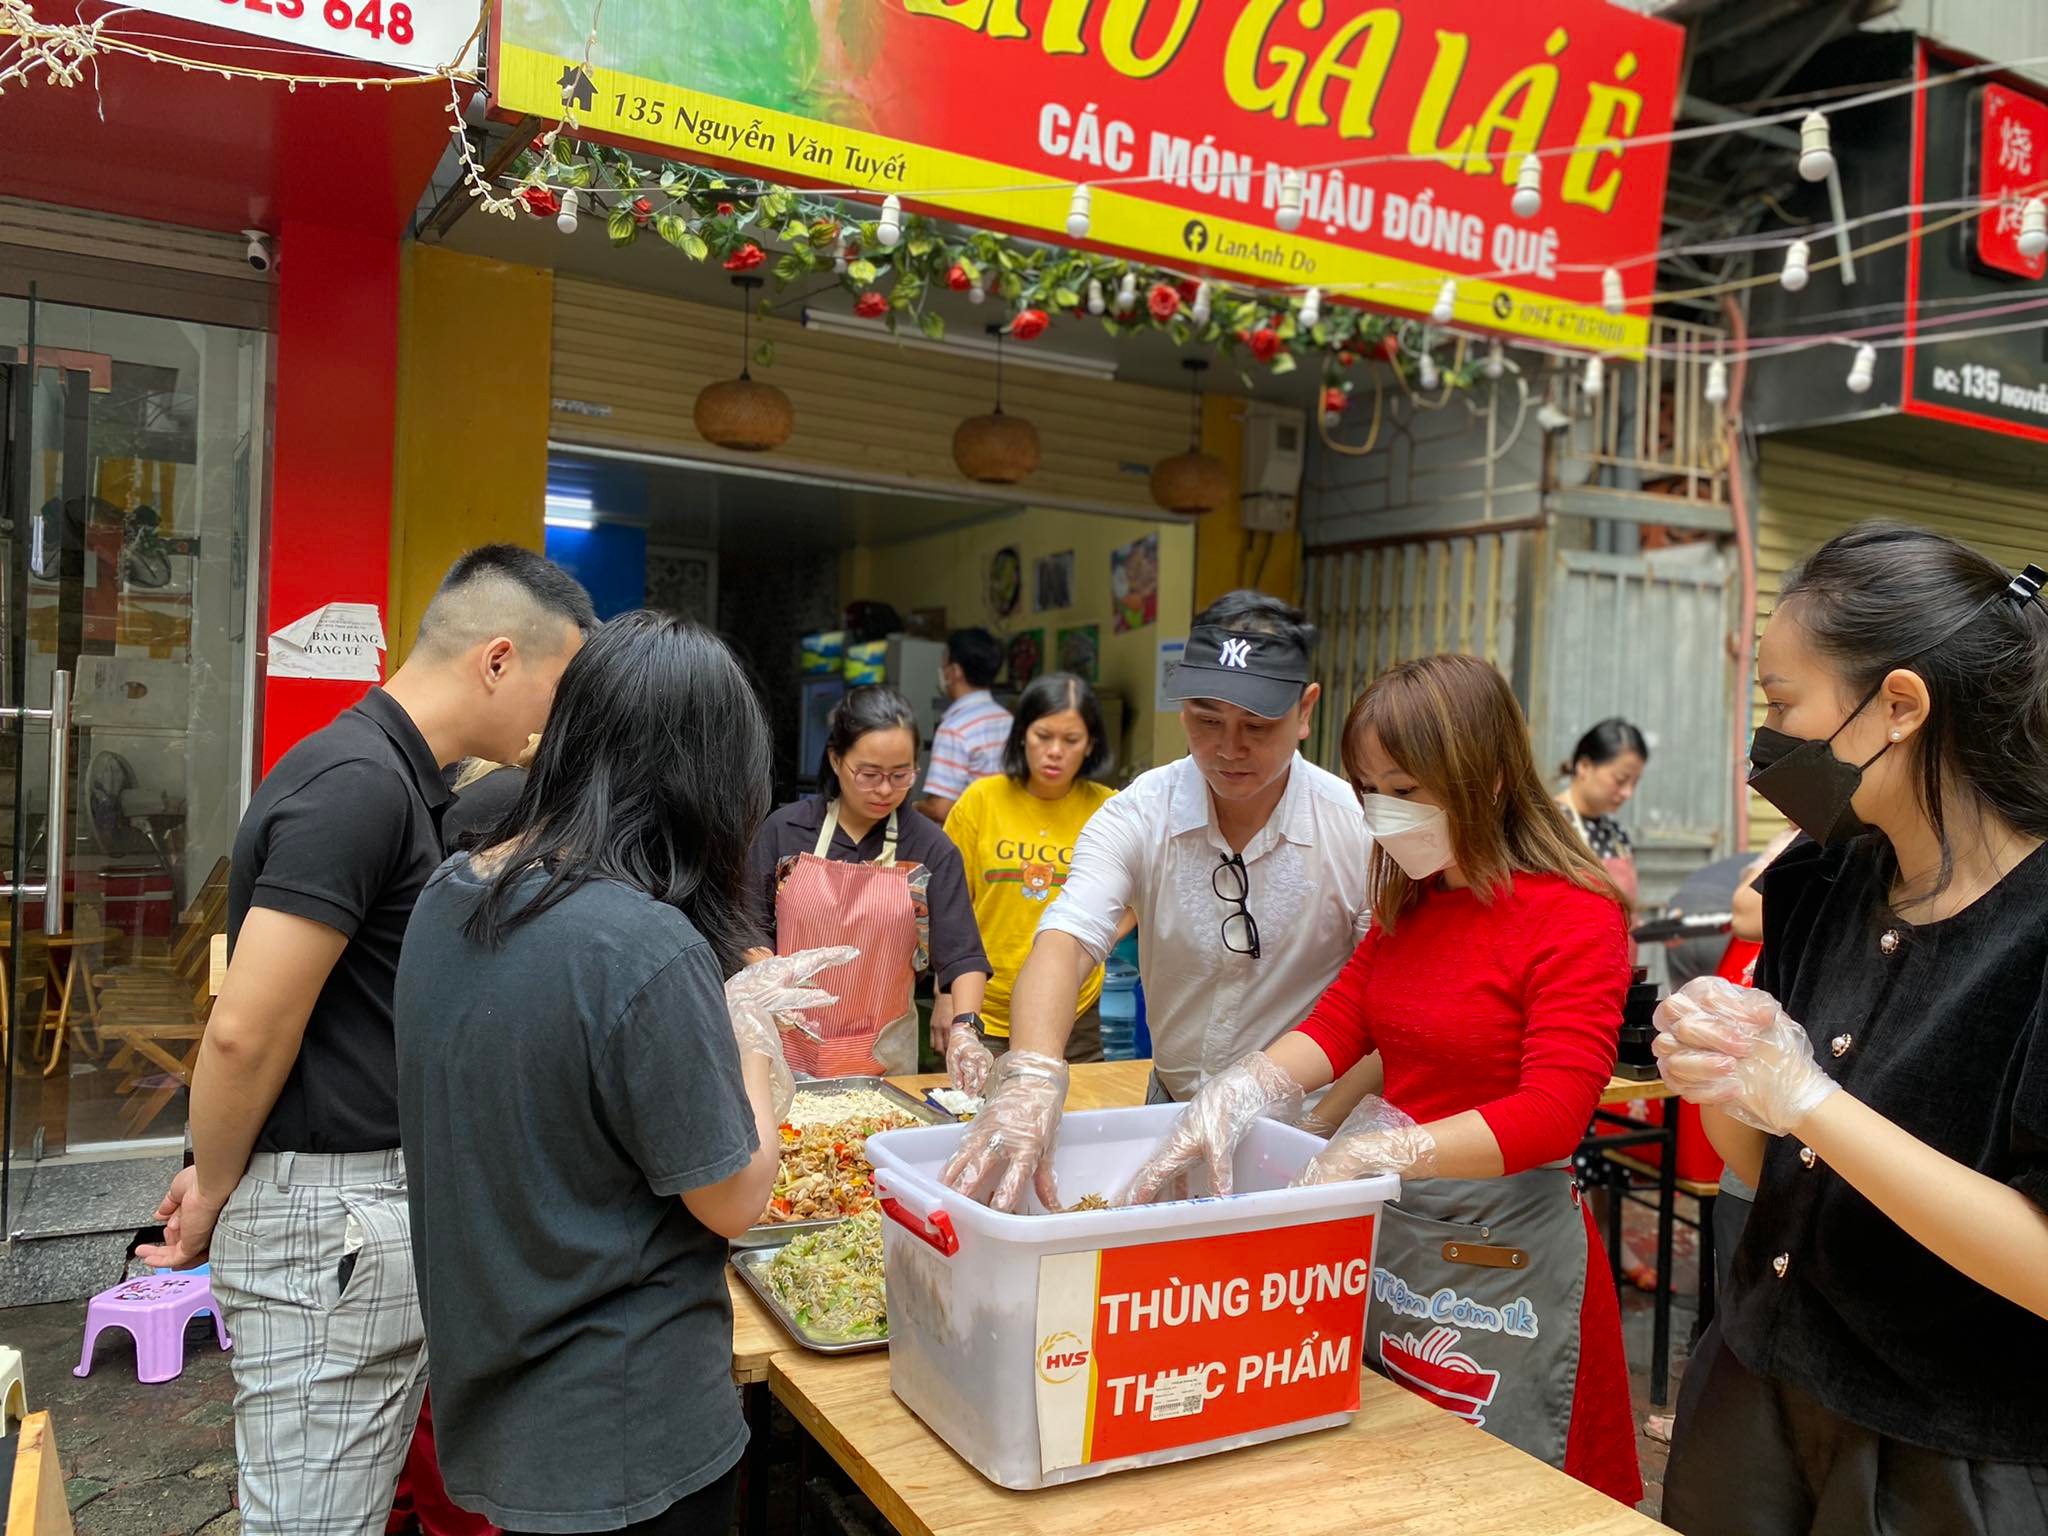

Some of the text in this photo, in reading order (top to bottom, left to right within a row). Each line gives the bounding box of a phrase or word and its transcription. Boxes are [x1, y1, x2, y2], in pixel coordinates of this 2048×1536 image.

[323, 0, 415, 46] 648
[1407, 27, 1568, 187] LÁ
[614, 92, 907, 184] 135 Nguyễn Văn Tuyết
[1038, 102, 1135, 173] CÁC
[1148, 134, 1253, 204] MÓN
[1261, 161, 1375, 235] NHẬU
[1491, 224, 1561, 281] QUÊ
[1961, 362, 2001, 403] 135
[303, 645, 341, 656] MANG
[1219, 637, 1252, 669] NY
[995, 839, 1074, 865] GUCC
[1100, 1258, 1368, 1335] THÙNG ĐỰNG
[1374, 1270, 1428, 1314] Tiệm
[1431, 1291, 1498, 1328] Cơm
[1045, 1349, 1090, 1370] HVS
[1106, 1361, 1227, 1417] THC
[1236, 1330, 1352, 1394] PHẨM
